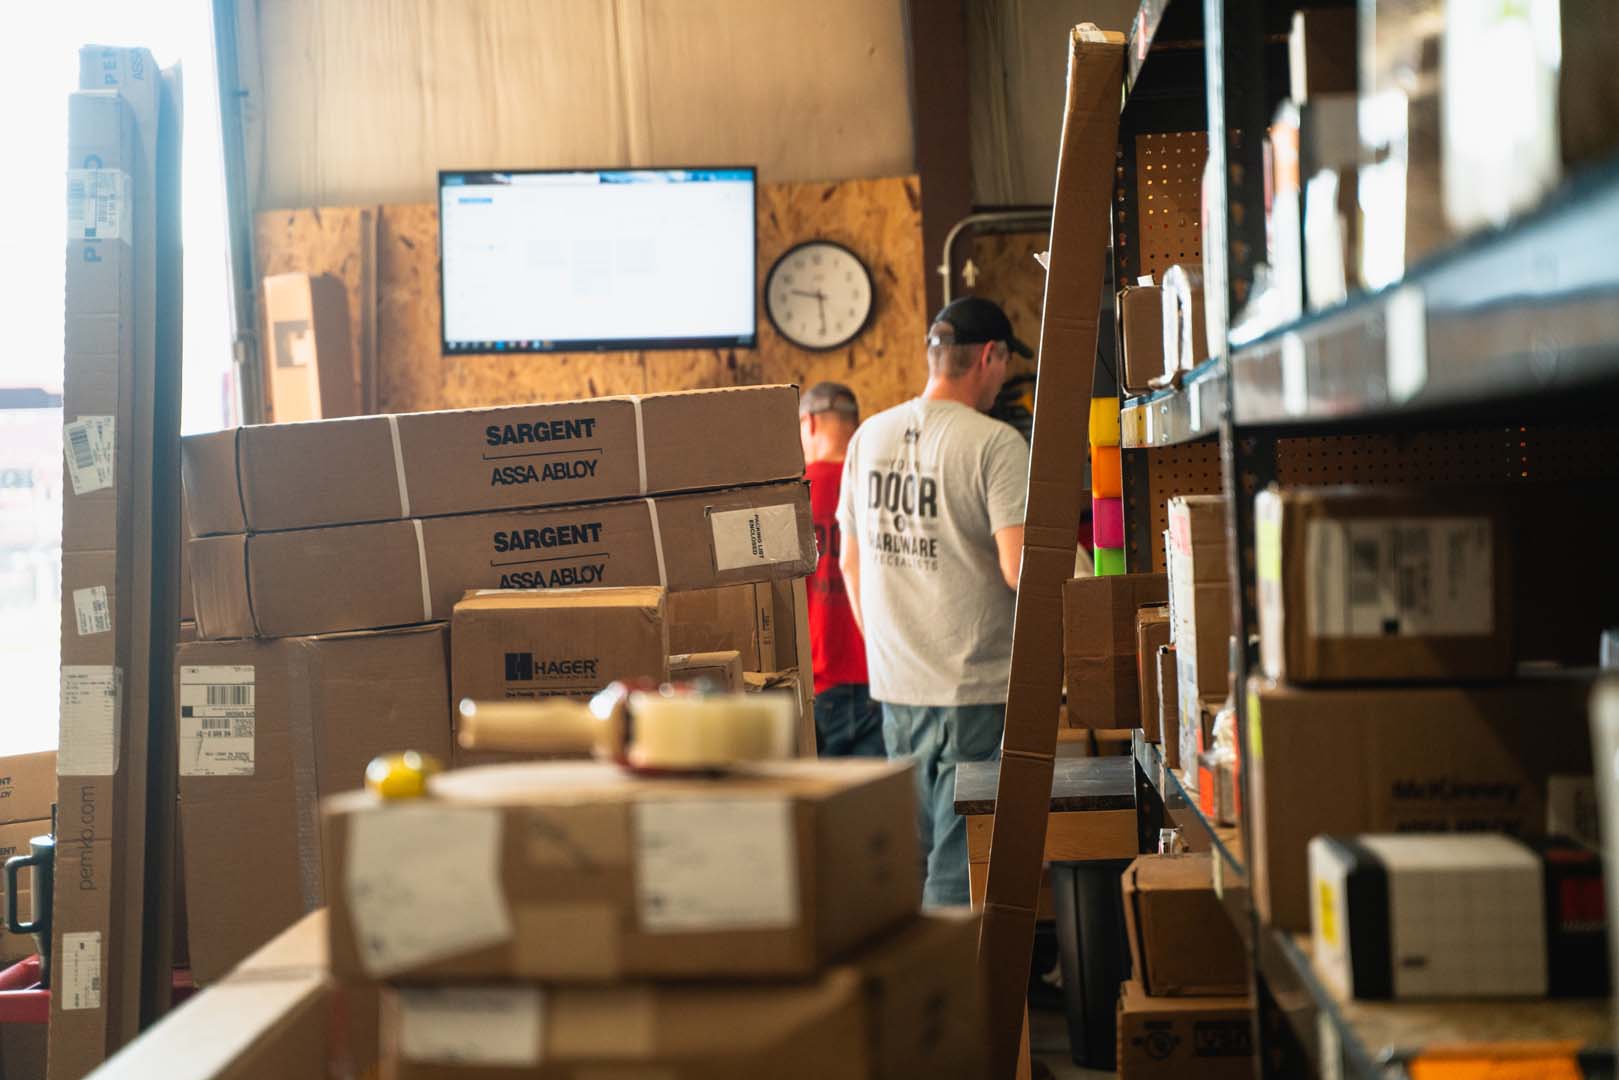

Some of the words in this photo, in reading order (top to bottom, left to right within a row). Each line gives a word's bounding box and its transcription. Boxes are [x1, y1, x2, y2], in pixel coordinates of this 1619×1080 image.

[486, 418, 595, 446] SARGENT
[491, 464, 540, 486] ASSA
[541, 459, 598, 482] ABLOY
[868, 470, 937, 517] DOOR
[494, 522, 603, 553] SARGENT
[749, 520, 757, 555] ENCLOSED
[500, 571, 548, 589] ASSA
[549, 564, 606, 588] ABLOY
[534, 660, 597, 675] HAGER
[80, 785, 97, 890] pemko.com
